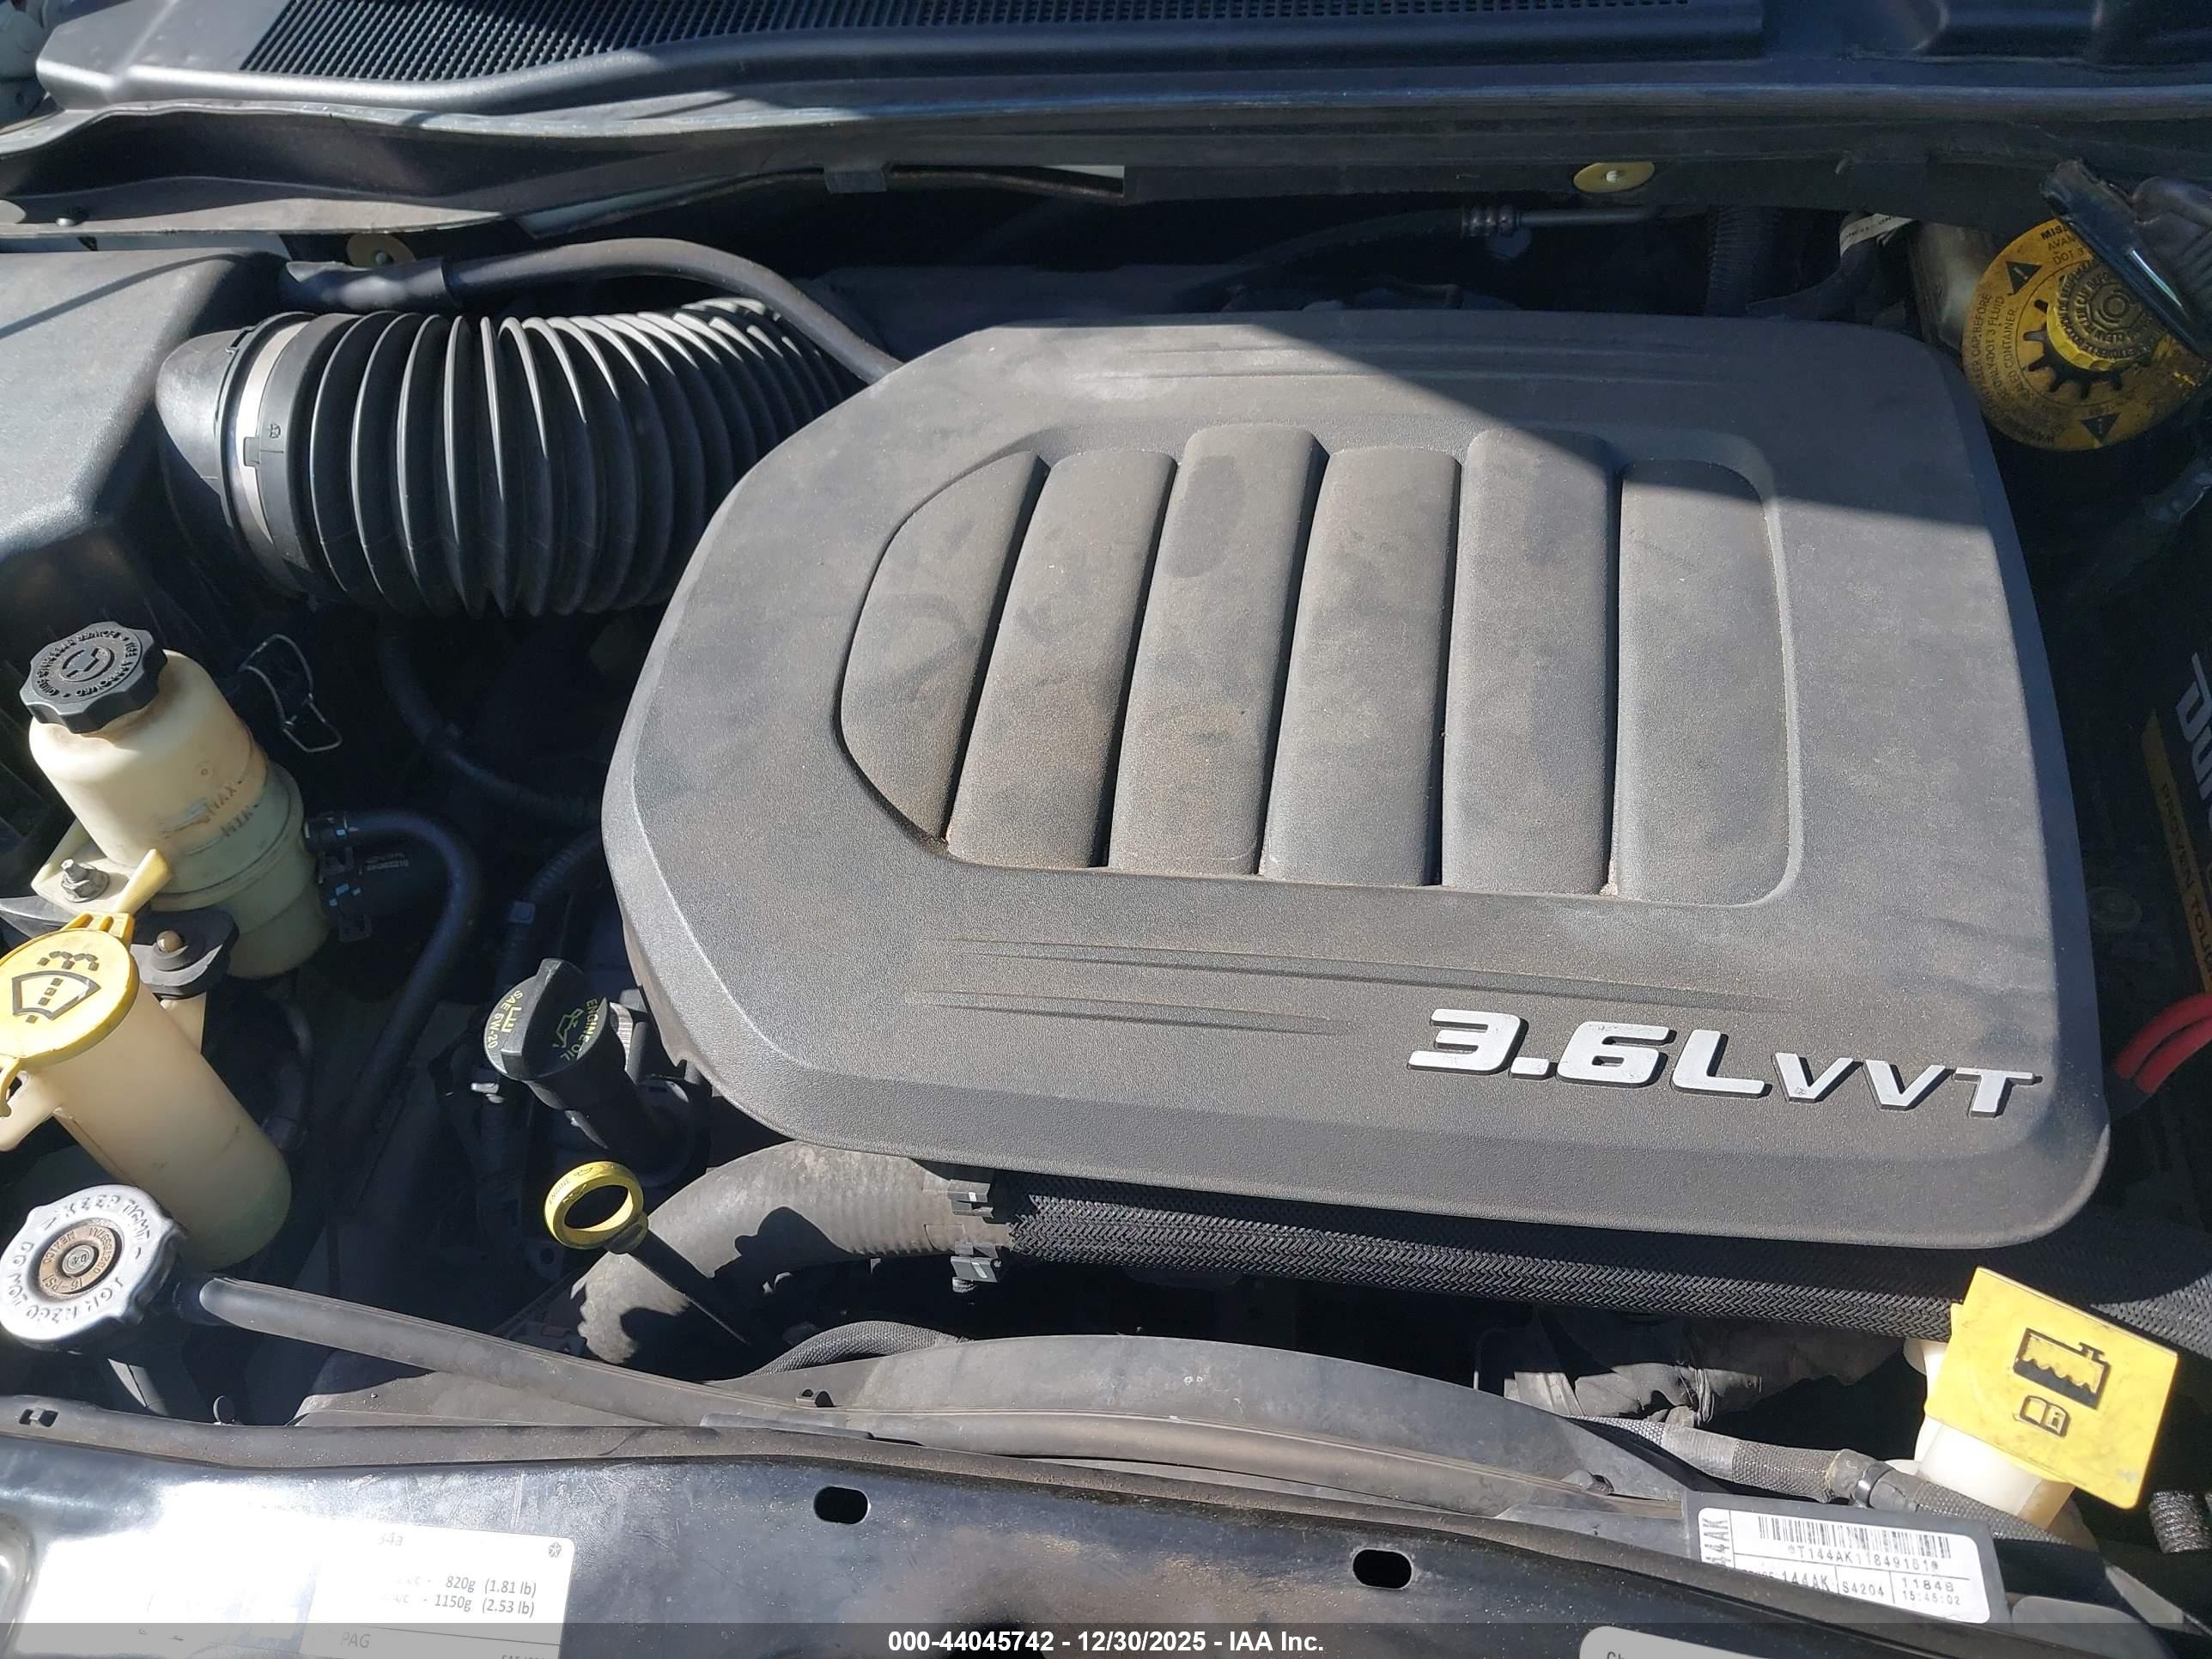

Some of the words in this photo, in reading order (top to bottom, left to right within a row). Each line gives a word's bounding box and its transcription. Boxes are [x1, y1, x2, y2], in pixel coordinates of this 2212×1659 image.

[2053, 250, 2074, 264] DOT
[1973, 294, 1992, 334] BEFORE
[1988, 295, 2005, 326] FLUID
[501, 990, 523, 1011] SAE
[487, 1013, 505, 1048] 5W-20
[578, 999, 599, 1042] ENGINE
[560, 1043, 581, 1061] OIL
[446, 1576, 476, 1594] 820g
[484, 1578, 516, 1595] (1.81
[520, 1582, 537, 1599] lb)
[1842, 1581, 1885, 1597] S4204
[434, 1593, 472, 1613] 1150g
[482, 1598, 514, 1614] (2.53
[517, 1601, 535, 1619] lb)
[340, 1632, 371, 1649] PAG
